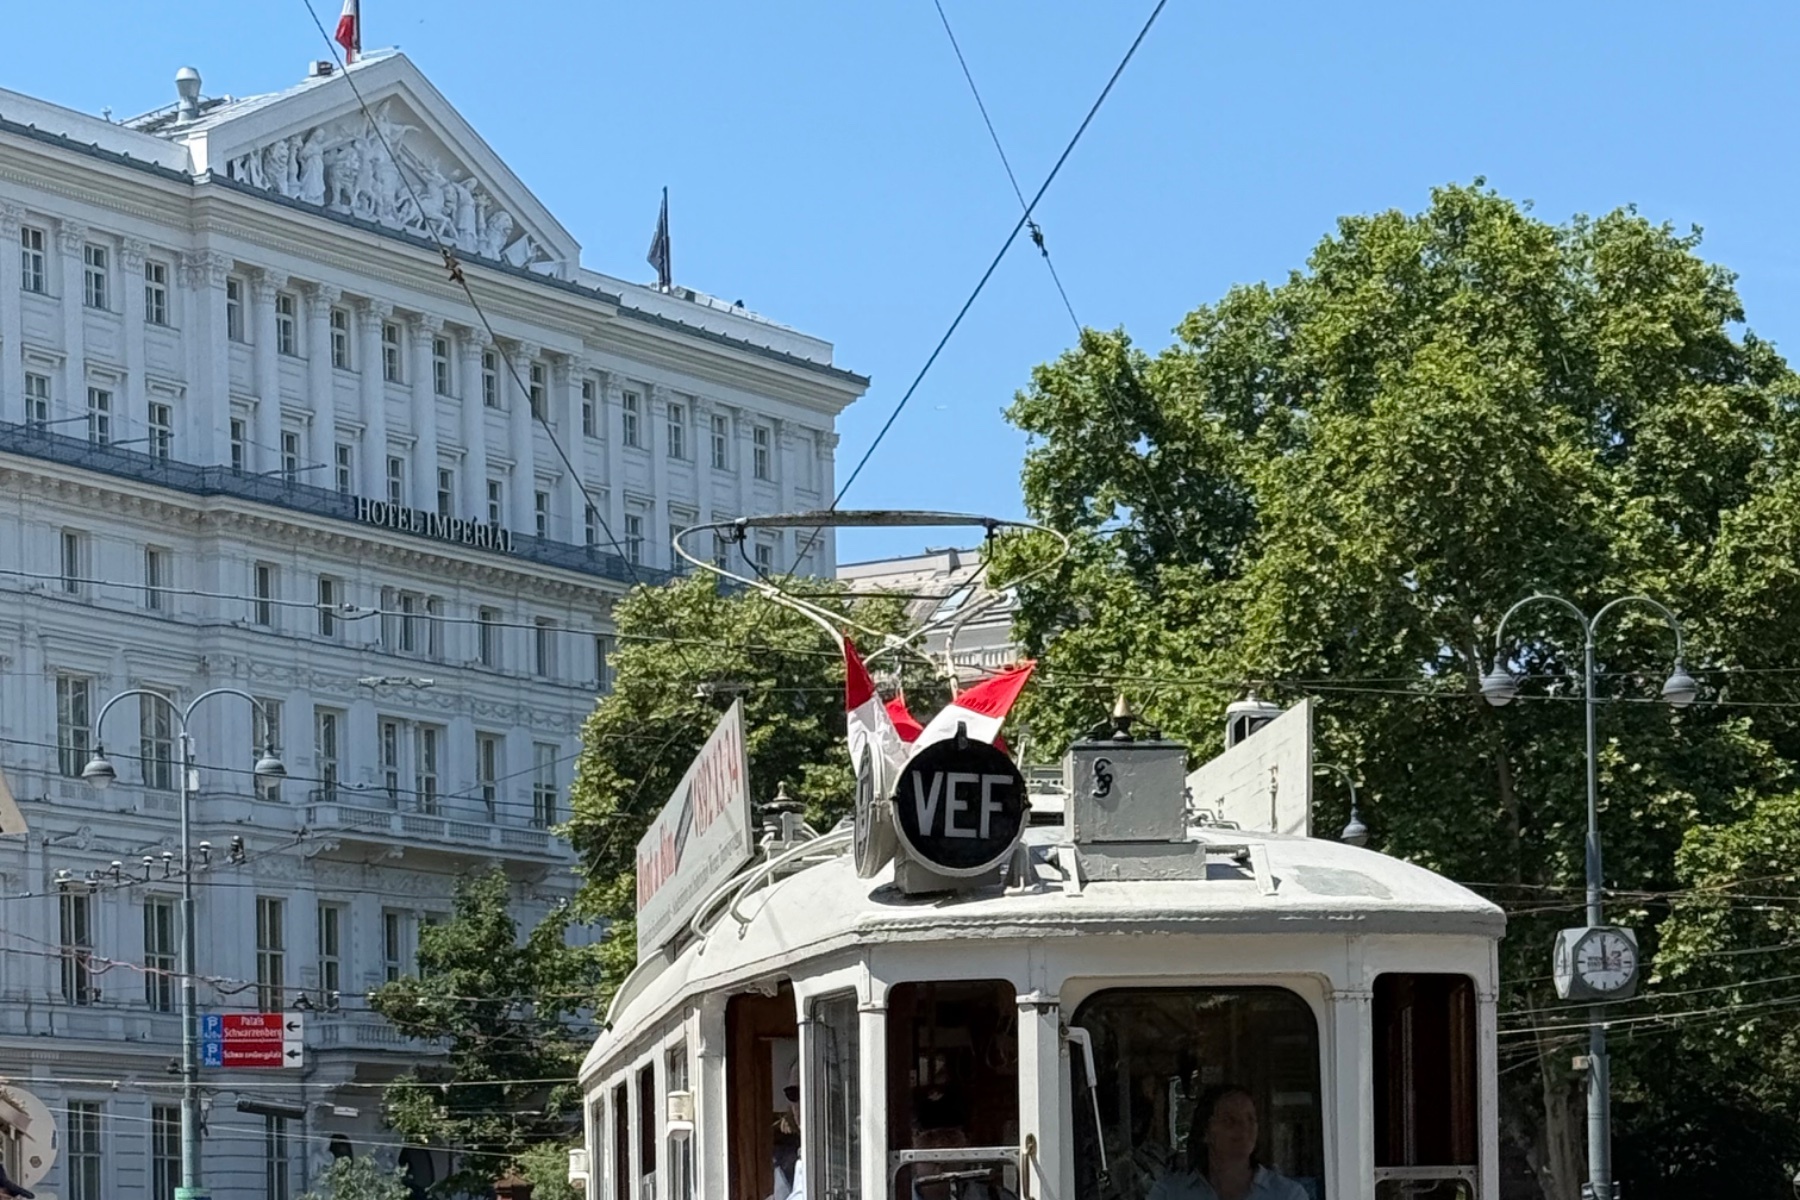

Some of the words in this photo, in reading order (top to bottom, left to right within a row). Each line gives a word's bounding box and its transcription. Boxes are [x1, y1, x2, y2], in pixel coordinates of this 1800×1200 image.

[356, 497, 421, 533] HOTEL
[426, 511, 518, 553] IMPERIAL
[912, 770, 1014, 840] VEF
